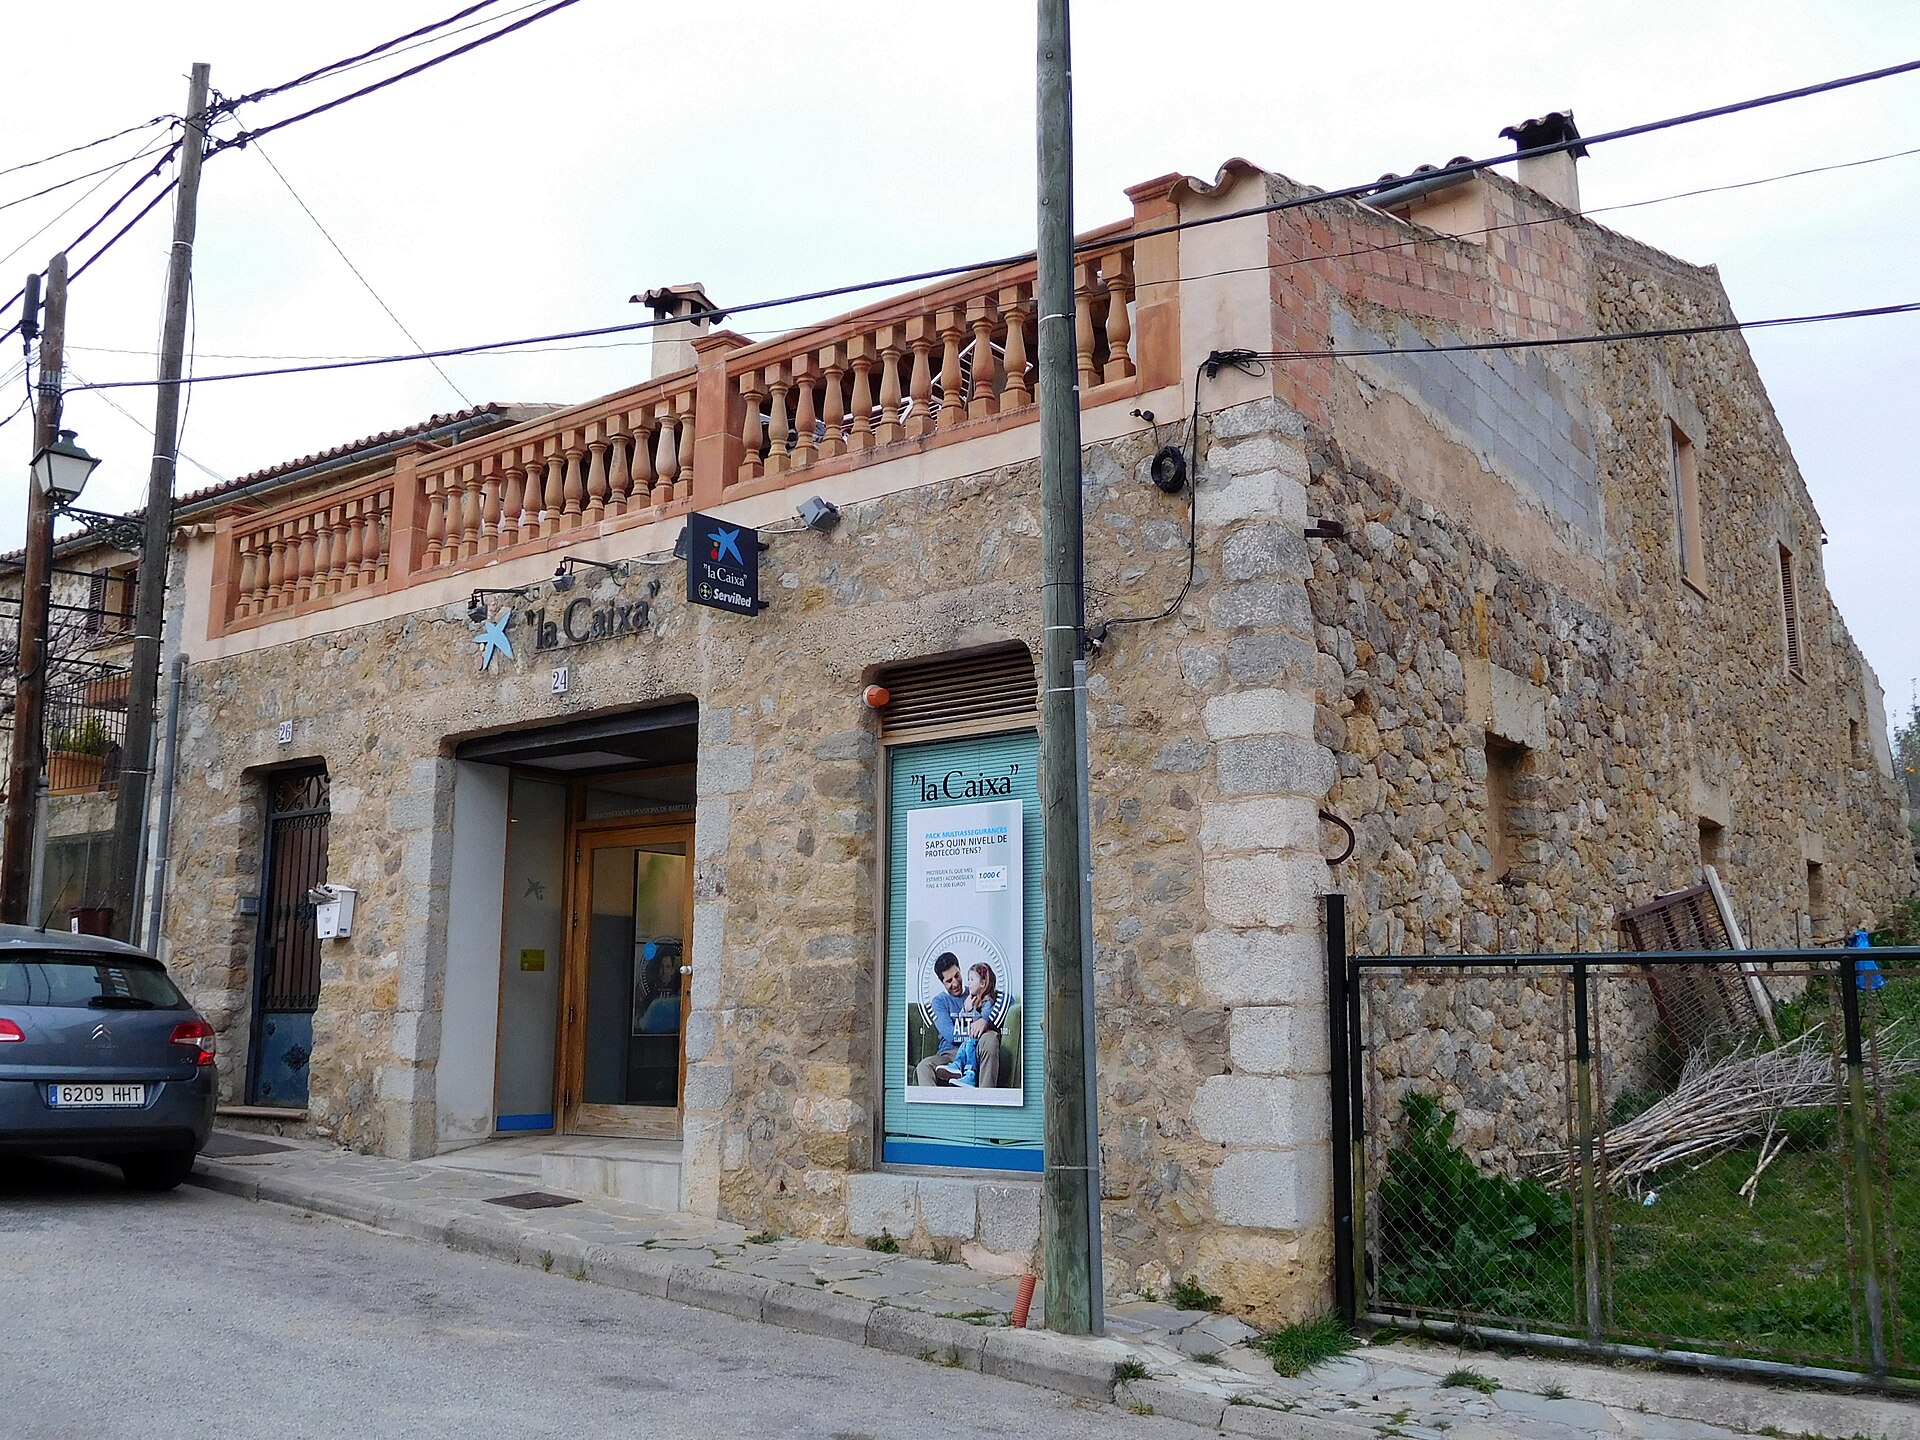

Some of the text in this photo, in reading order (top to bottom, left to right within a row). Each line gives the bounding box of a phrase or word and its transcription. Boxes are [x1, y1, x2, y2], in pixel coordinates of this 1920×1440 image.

[713, 588, 752, 608] ServiRed
[552, 669, 567, 691] 24
[280, 724, 291, 740] 26
[925, 834, 1008, 850] SAPS QUIN NIVELL DE
[925, 846, 982, 858] PROTECCIÓ TENS?
[953, 1018, 972, 1036] ALT
[63, 1087, 141, 1102] 6209 HHT
